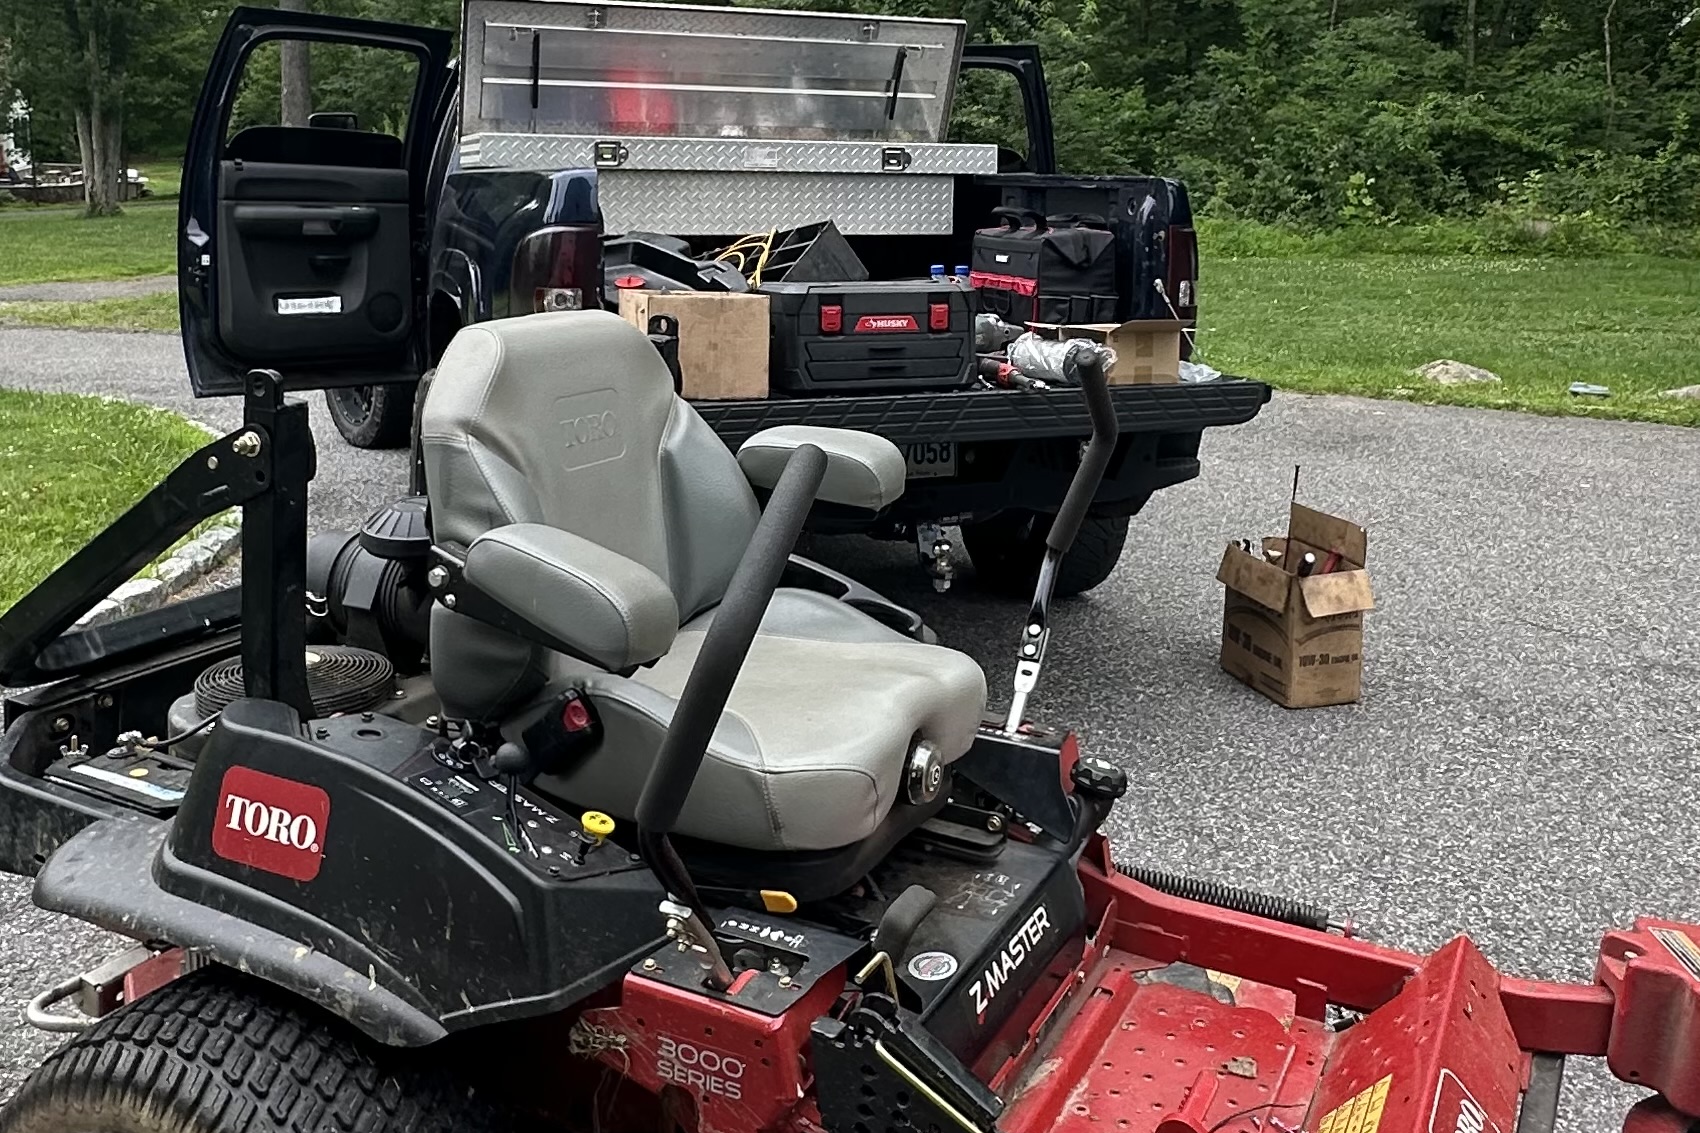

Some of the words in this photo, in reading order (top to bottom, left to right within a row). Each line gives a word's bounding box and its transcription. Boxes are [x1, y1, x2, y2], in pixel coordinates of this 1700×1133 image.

[876, 319, 909, 329] HUSKY
[559, 409, 617, 448] TORO
[225, 793, 318, 851] TORO
[968, 980, 989, 1015] Z
[984, 905, 1051, 998] MASTER
[656, 1035, 744, 1079] 3000
[656, 1059, 742, 1100] SERIES
